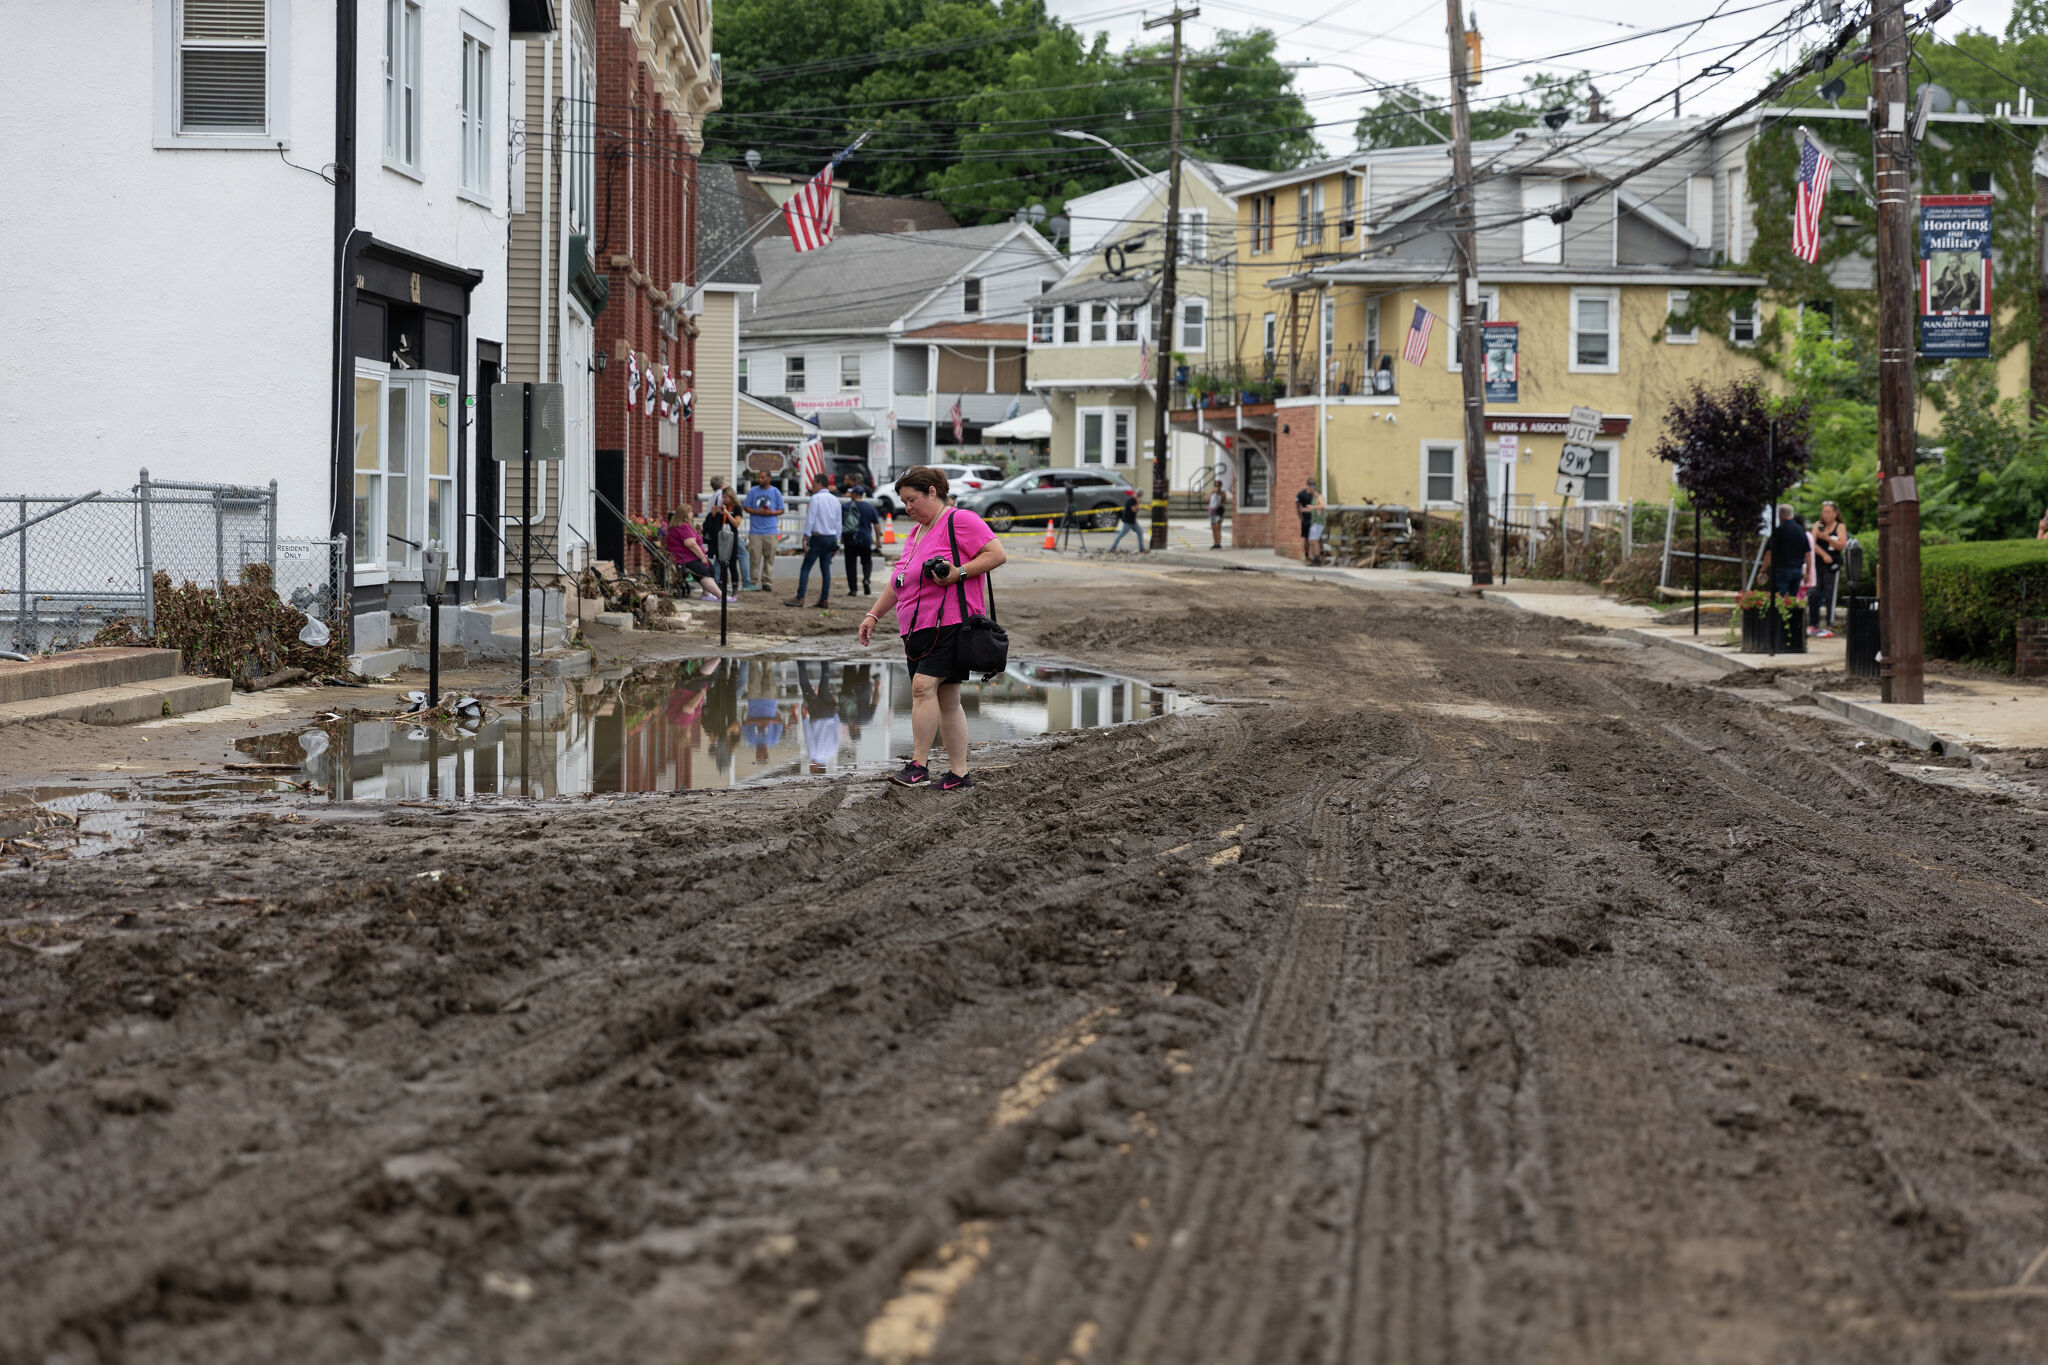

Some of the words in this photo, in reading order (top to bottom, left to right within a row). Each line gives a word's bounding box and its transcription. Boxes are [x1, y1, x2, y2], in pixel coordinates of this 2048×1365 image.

[1924, 219, 1989, 232] Honoring
[1930, 238, 1982, 250] Military
[1923, 320, 1989, 328] NANARTOWICH
[1519, 422, 1528, 431] &
[1569, 426, 1594, 442] JCT
[1566, 451, 1588, 470] 9W
[277, 544, 310, 552] RESIDENTS
